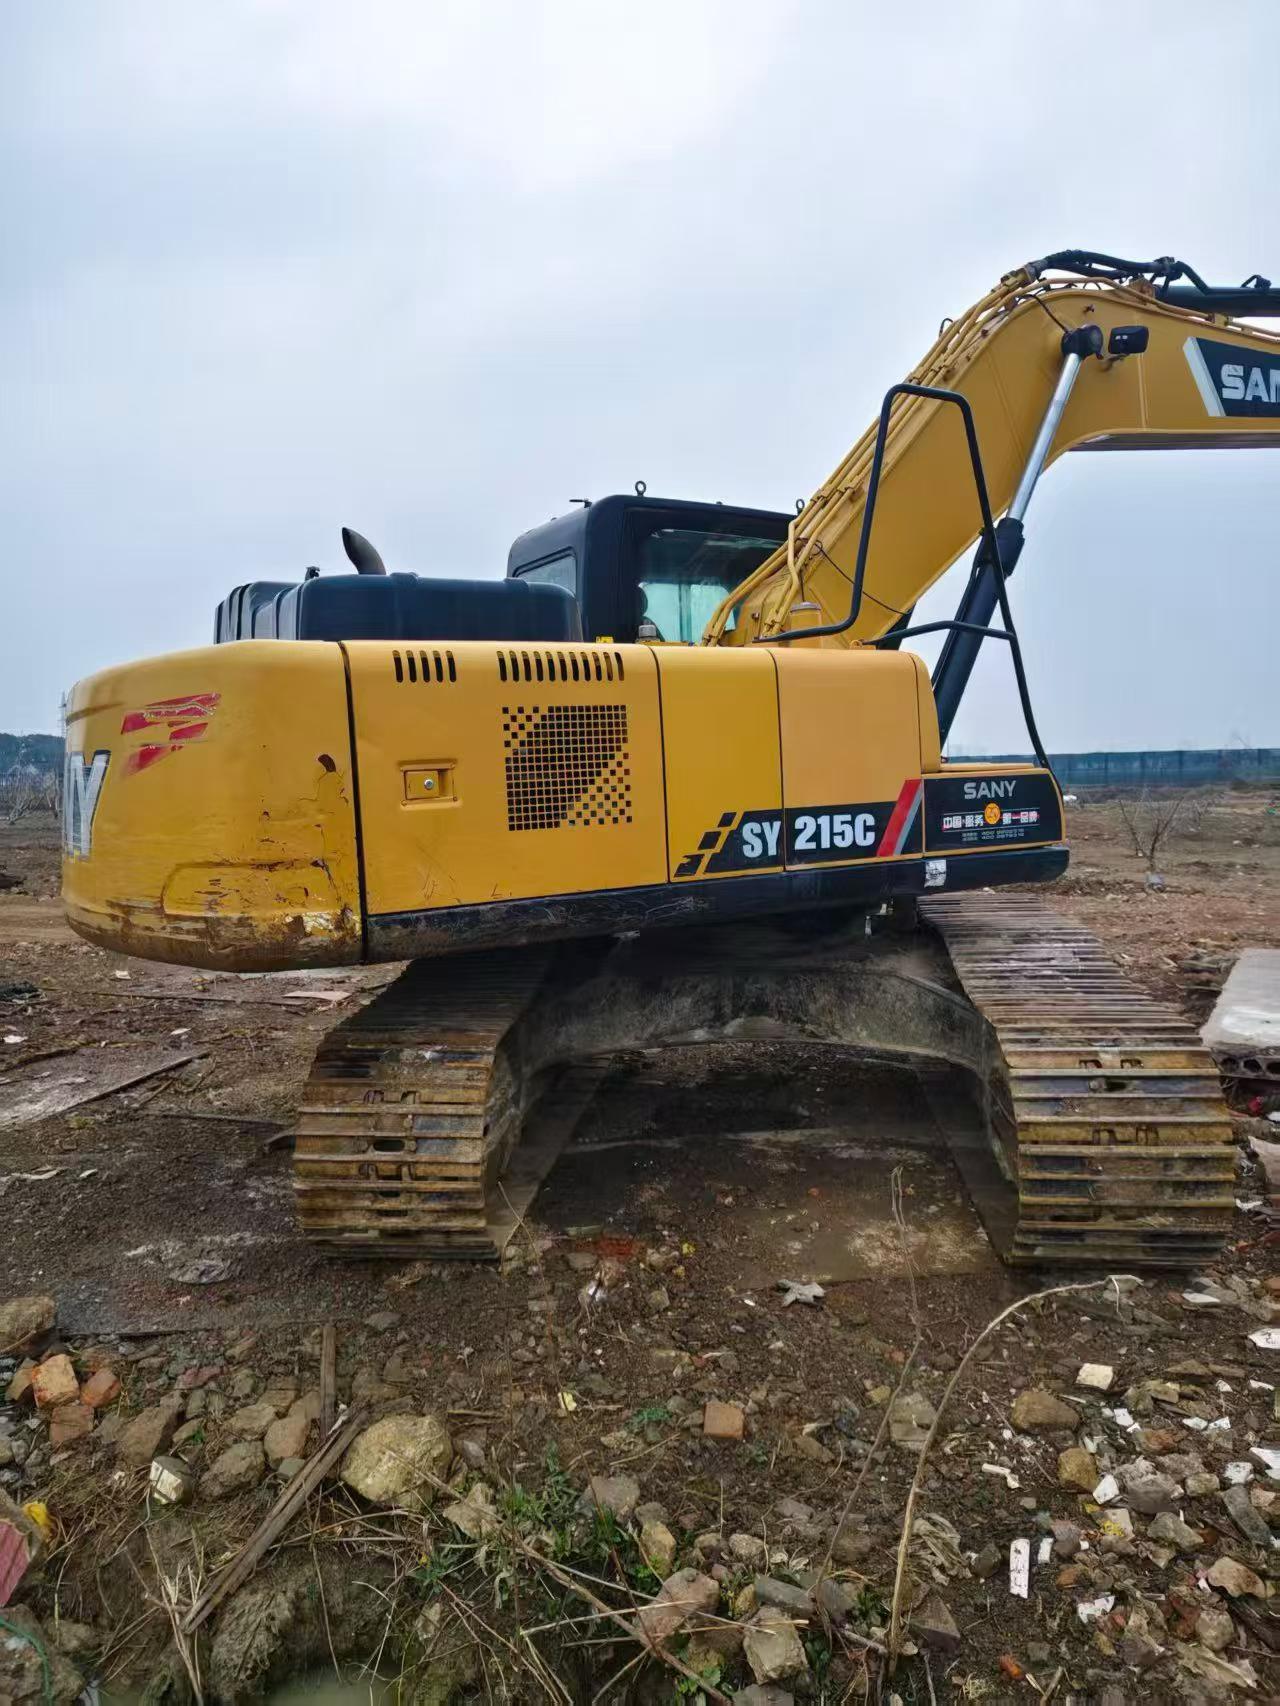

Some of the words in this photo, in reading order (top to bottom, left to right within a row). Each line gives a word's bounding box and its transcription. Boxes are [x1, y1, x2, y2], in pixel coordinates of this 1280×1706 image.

[963, 780, 1017, 800] SANY
[742, 821, 782, 858] SY
[794, 813, 876, 851] 215C
